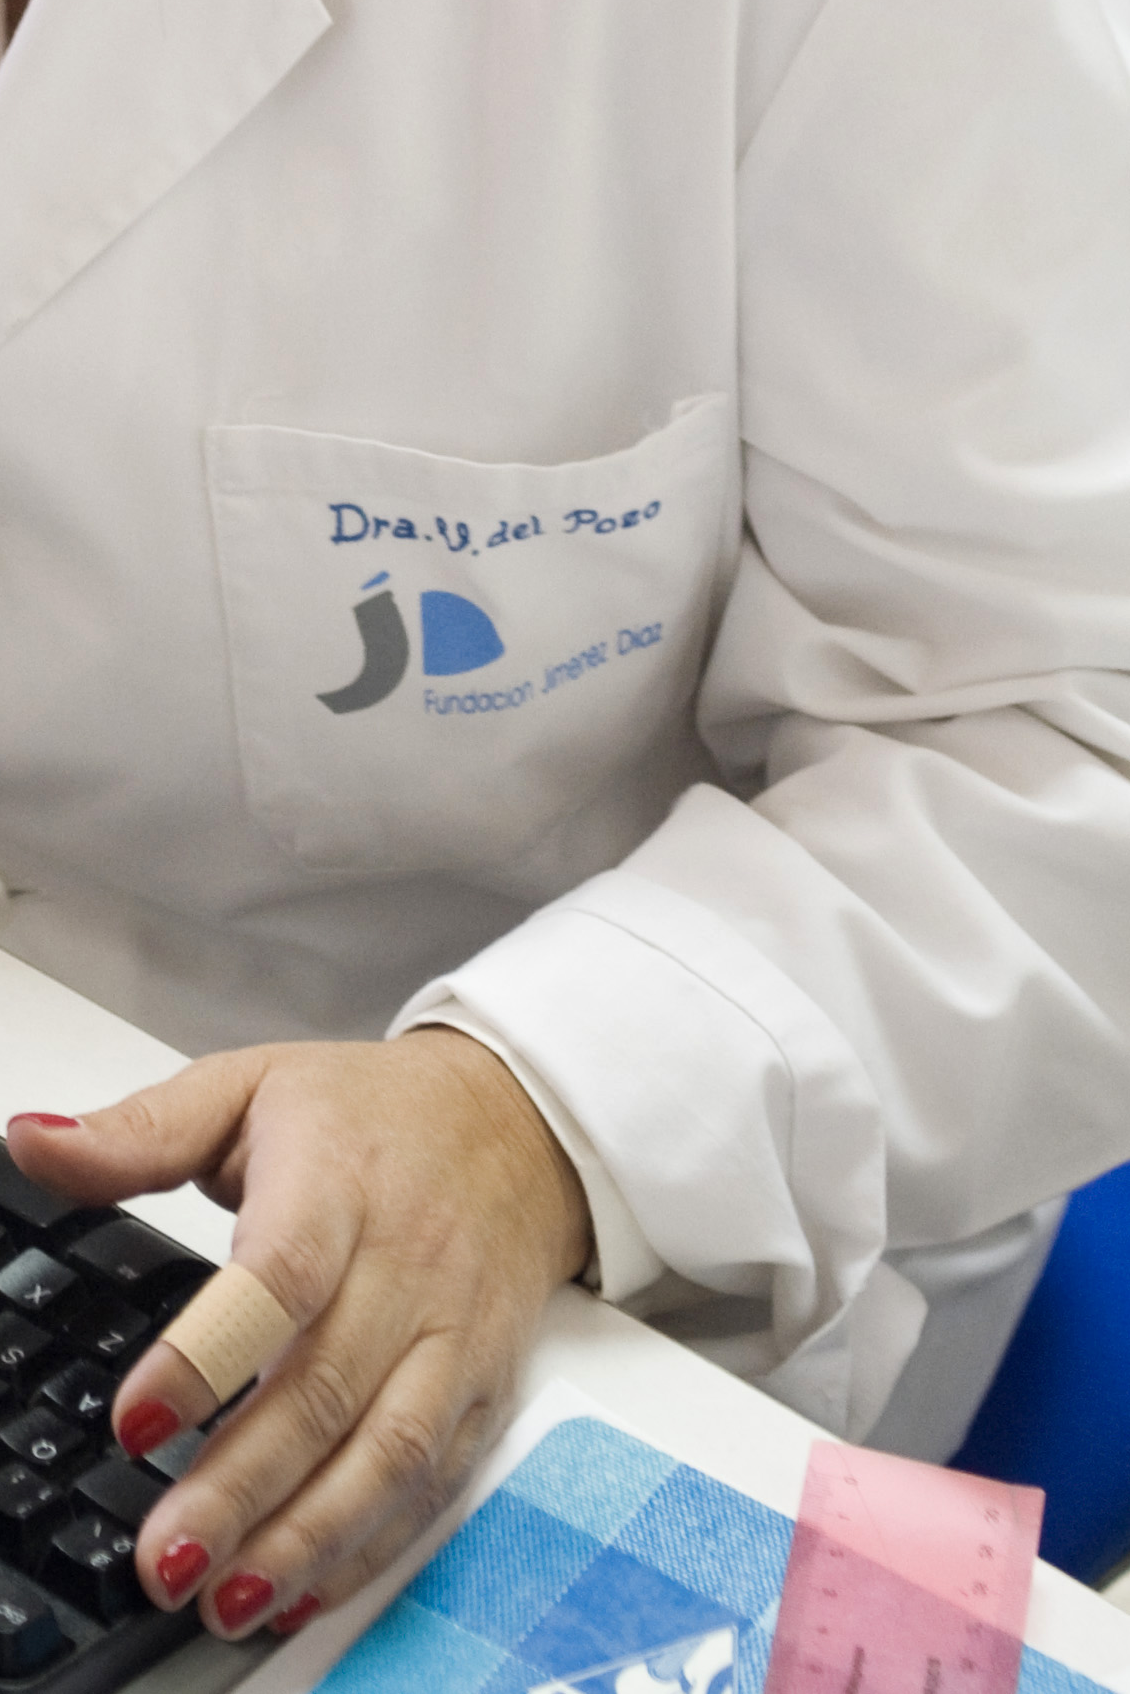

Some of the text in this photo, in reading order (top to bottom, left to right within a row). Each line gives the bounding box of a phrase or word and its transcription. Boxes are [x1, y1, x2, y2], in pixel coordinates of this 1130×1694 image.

[486, 514, 546, 549] del
[23, 1284, 52, 1304] X
[97, 1330, 125, 1353] Z
[0, 1347, 25, 1365] S
[78, 1392, 104, 1413] A
[31, 1439, 58, 1461] Q
